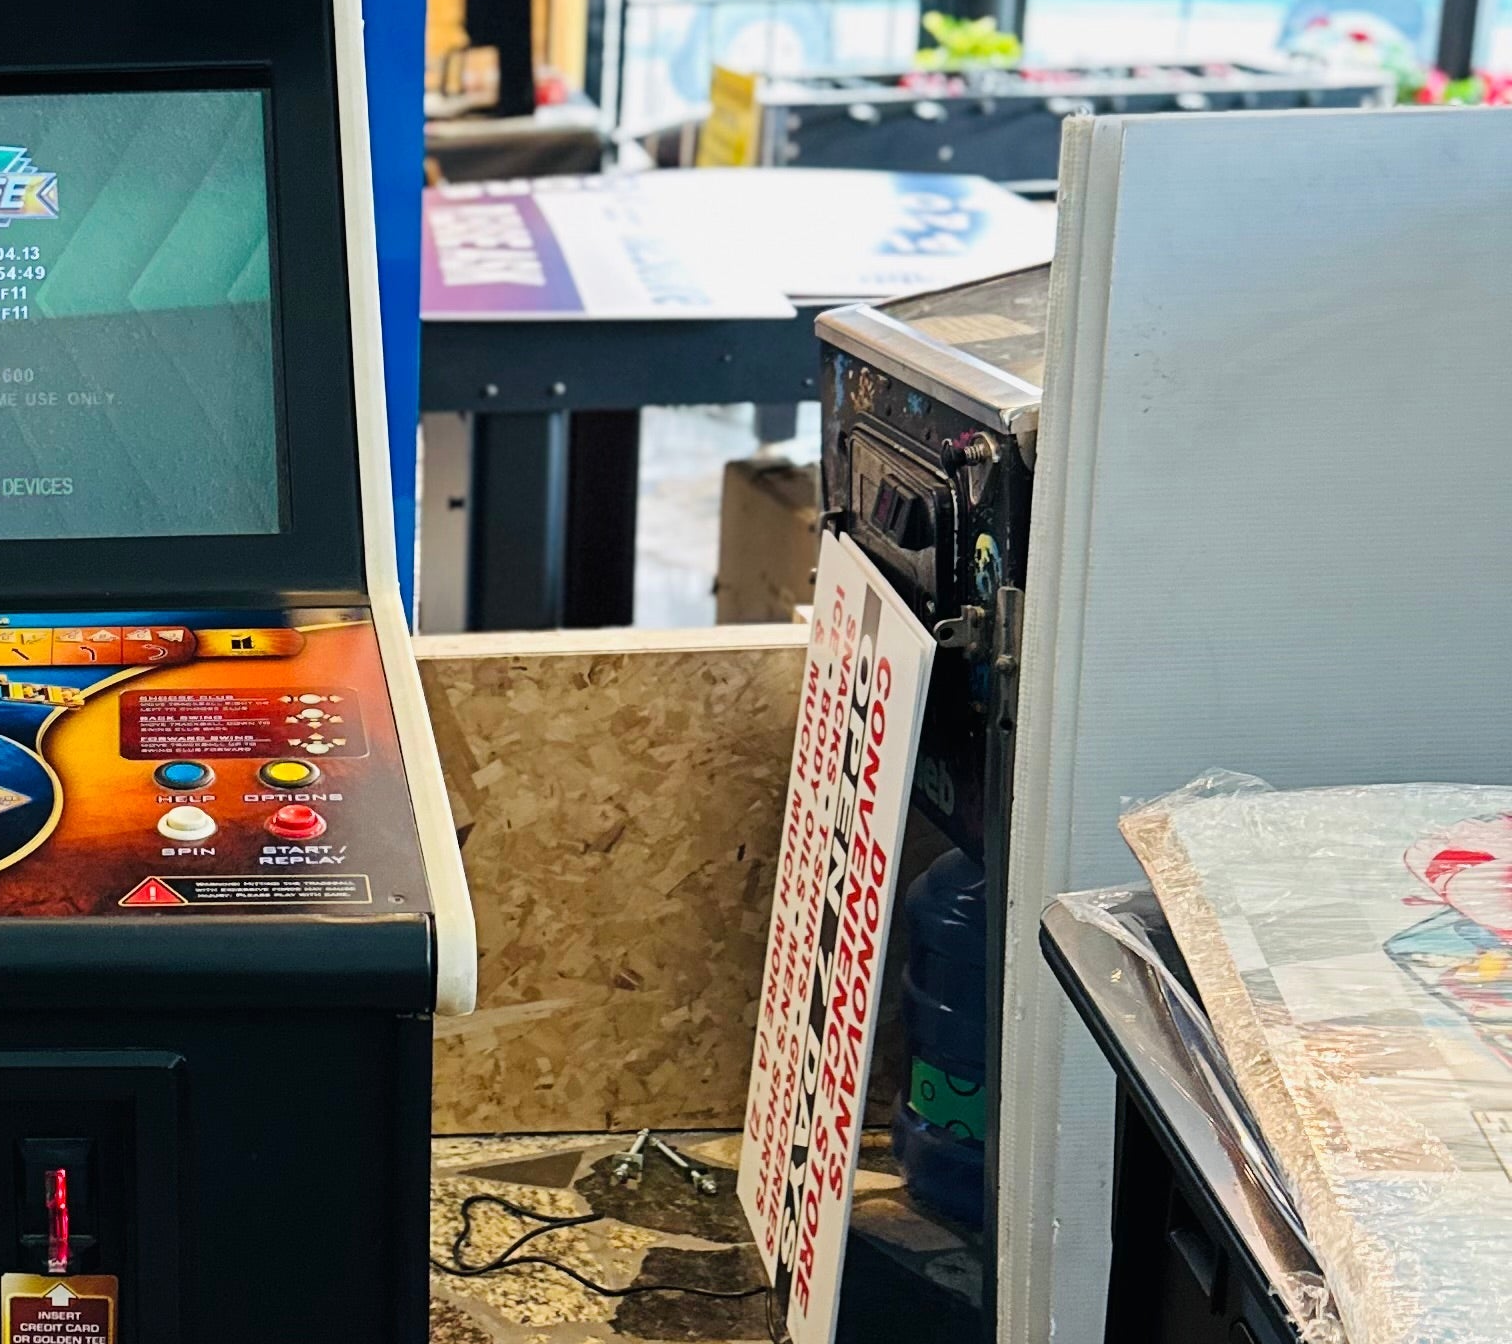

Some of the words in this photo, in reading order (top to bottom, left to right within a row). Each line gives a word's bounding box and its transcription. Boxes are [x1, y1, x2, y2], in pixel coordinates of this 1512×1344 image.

[2, 367, 35, 384] 600
[2, 477, 74, 496] DEVICES
[814, 617, 825, 646] &
[829, 584, 846, 656] ICE
[796, 659, 821, 784] MUCH
[810, 686, 832, 805] BODY
[826, 613, 857, 788] SNACKS
[157, 794, 217, 804] HELP
[243, 793, 343, 803] OPTIONS
[825, 633, 874, 918] OPEN
[161, 847, 217, 857] SPIN
[262, 845, 334, 855] START
[259, 855, 347, 866] REPLAY
[779, 788, 803, 908] MUCH
[797, 809, 815, 904] OILS
[819, 655, 892, 1110] CONVENIENCE
[763, 913, 786, 1031] MORE
[797, 824, 829, 1005] T-SHIRTS
[775, 930, 799, 1053] MEN'S
[816, 946, 833, 1007] 7
[828, 838, 888, 1202] DONOVAN'S
[755, 1059, 782, 1219] SHORTS
[764, 1039, 800, 1258] GROCERIES
[781, 1024, 821, 1273] DAYS
[794, 1114, 830, 1320] STORE
[13, 1335, 30, 1344] OR
[33, 1335, 83, 1344] GOLDEN
[20, 1323, 64, 1333] CREDIT
[66, 1323, 100, 1333] CARD
[38, 1311, 82, 1321] INSERT
